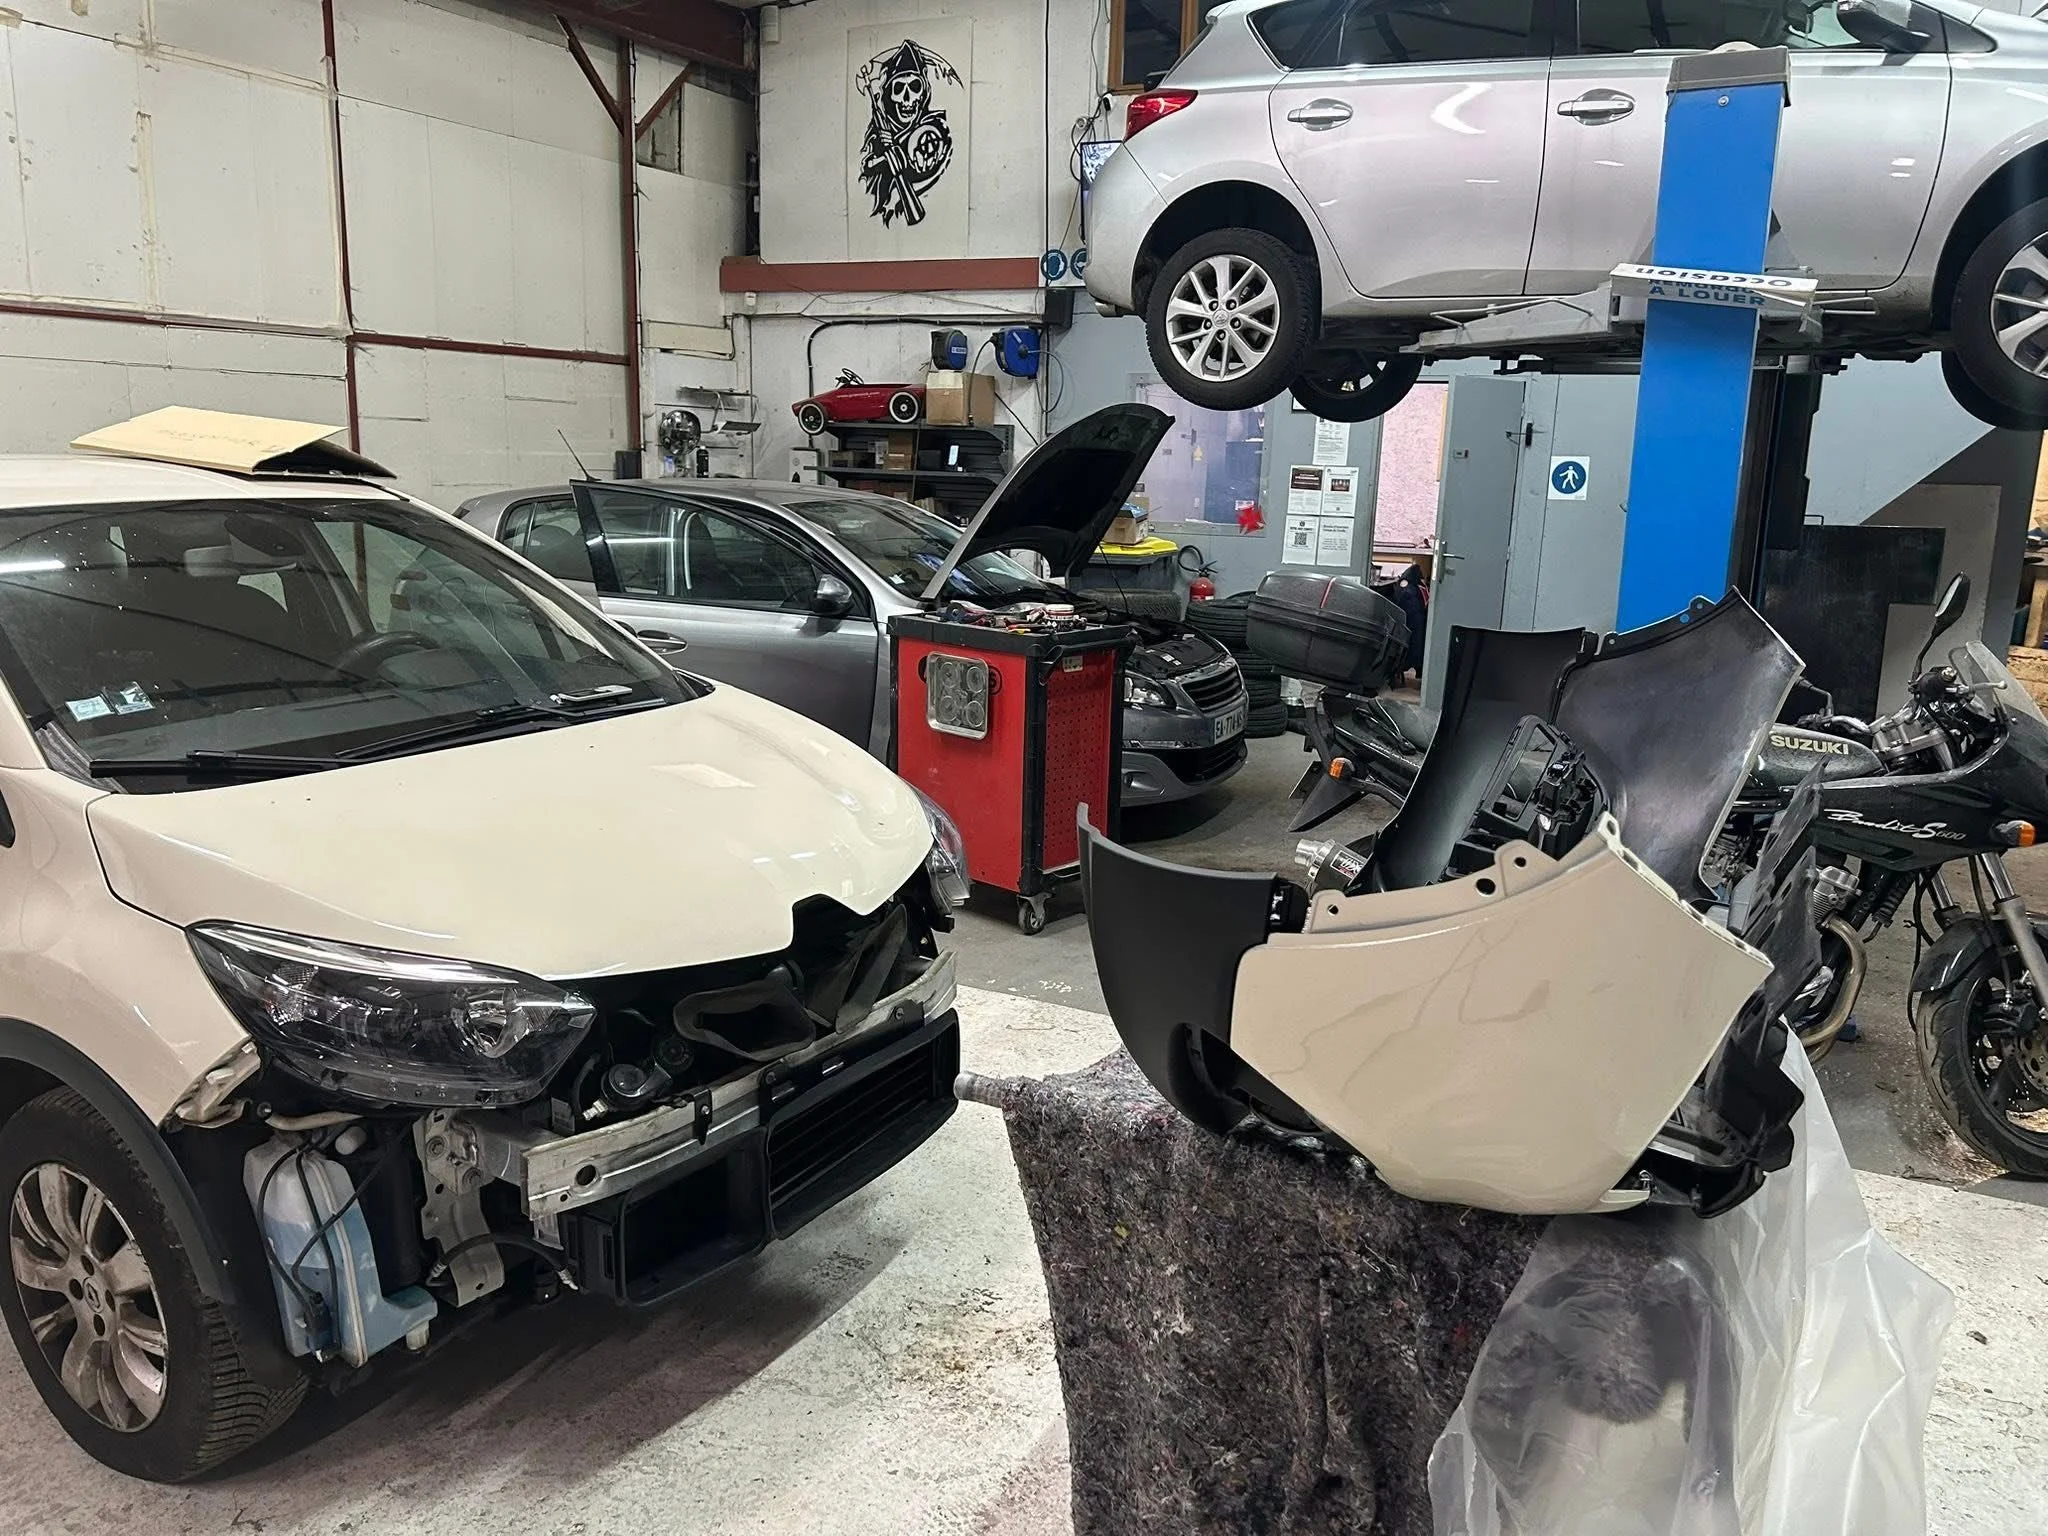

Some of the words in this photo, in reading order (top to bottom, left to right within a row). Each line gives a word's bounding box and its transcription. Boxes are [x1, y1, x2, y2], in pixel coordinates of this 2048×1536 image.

[1649, 286, 1665, 296] A
[1679, 288, 1766, 306] LOUER
[1770, 735, 1849, 755] SUZUKI
[1823, 808, 1921, 834] Bandit
